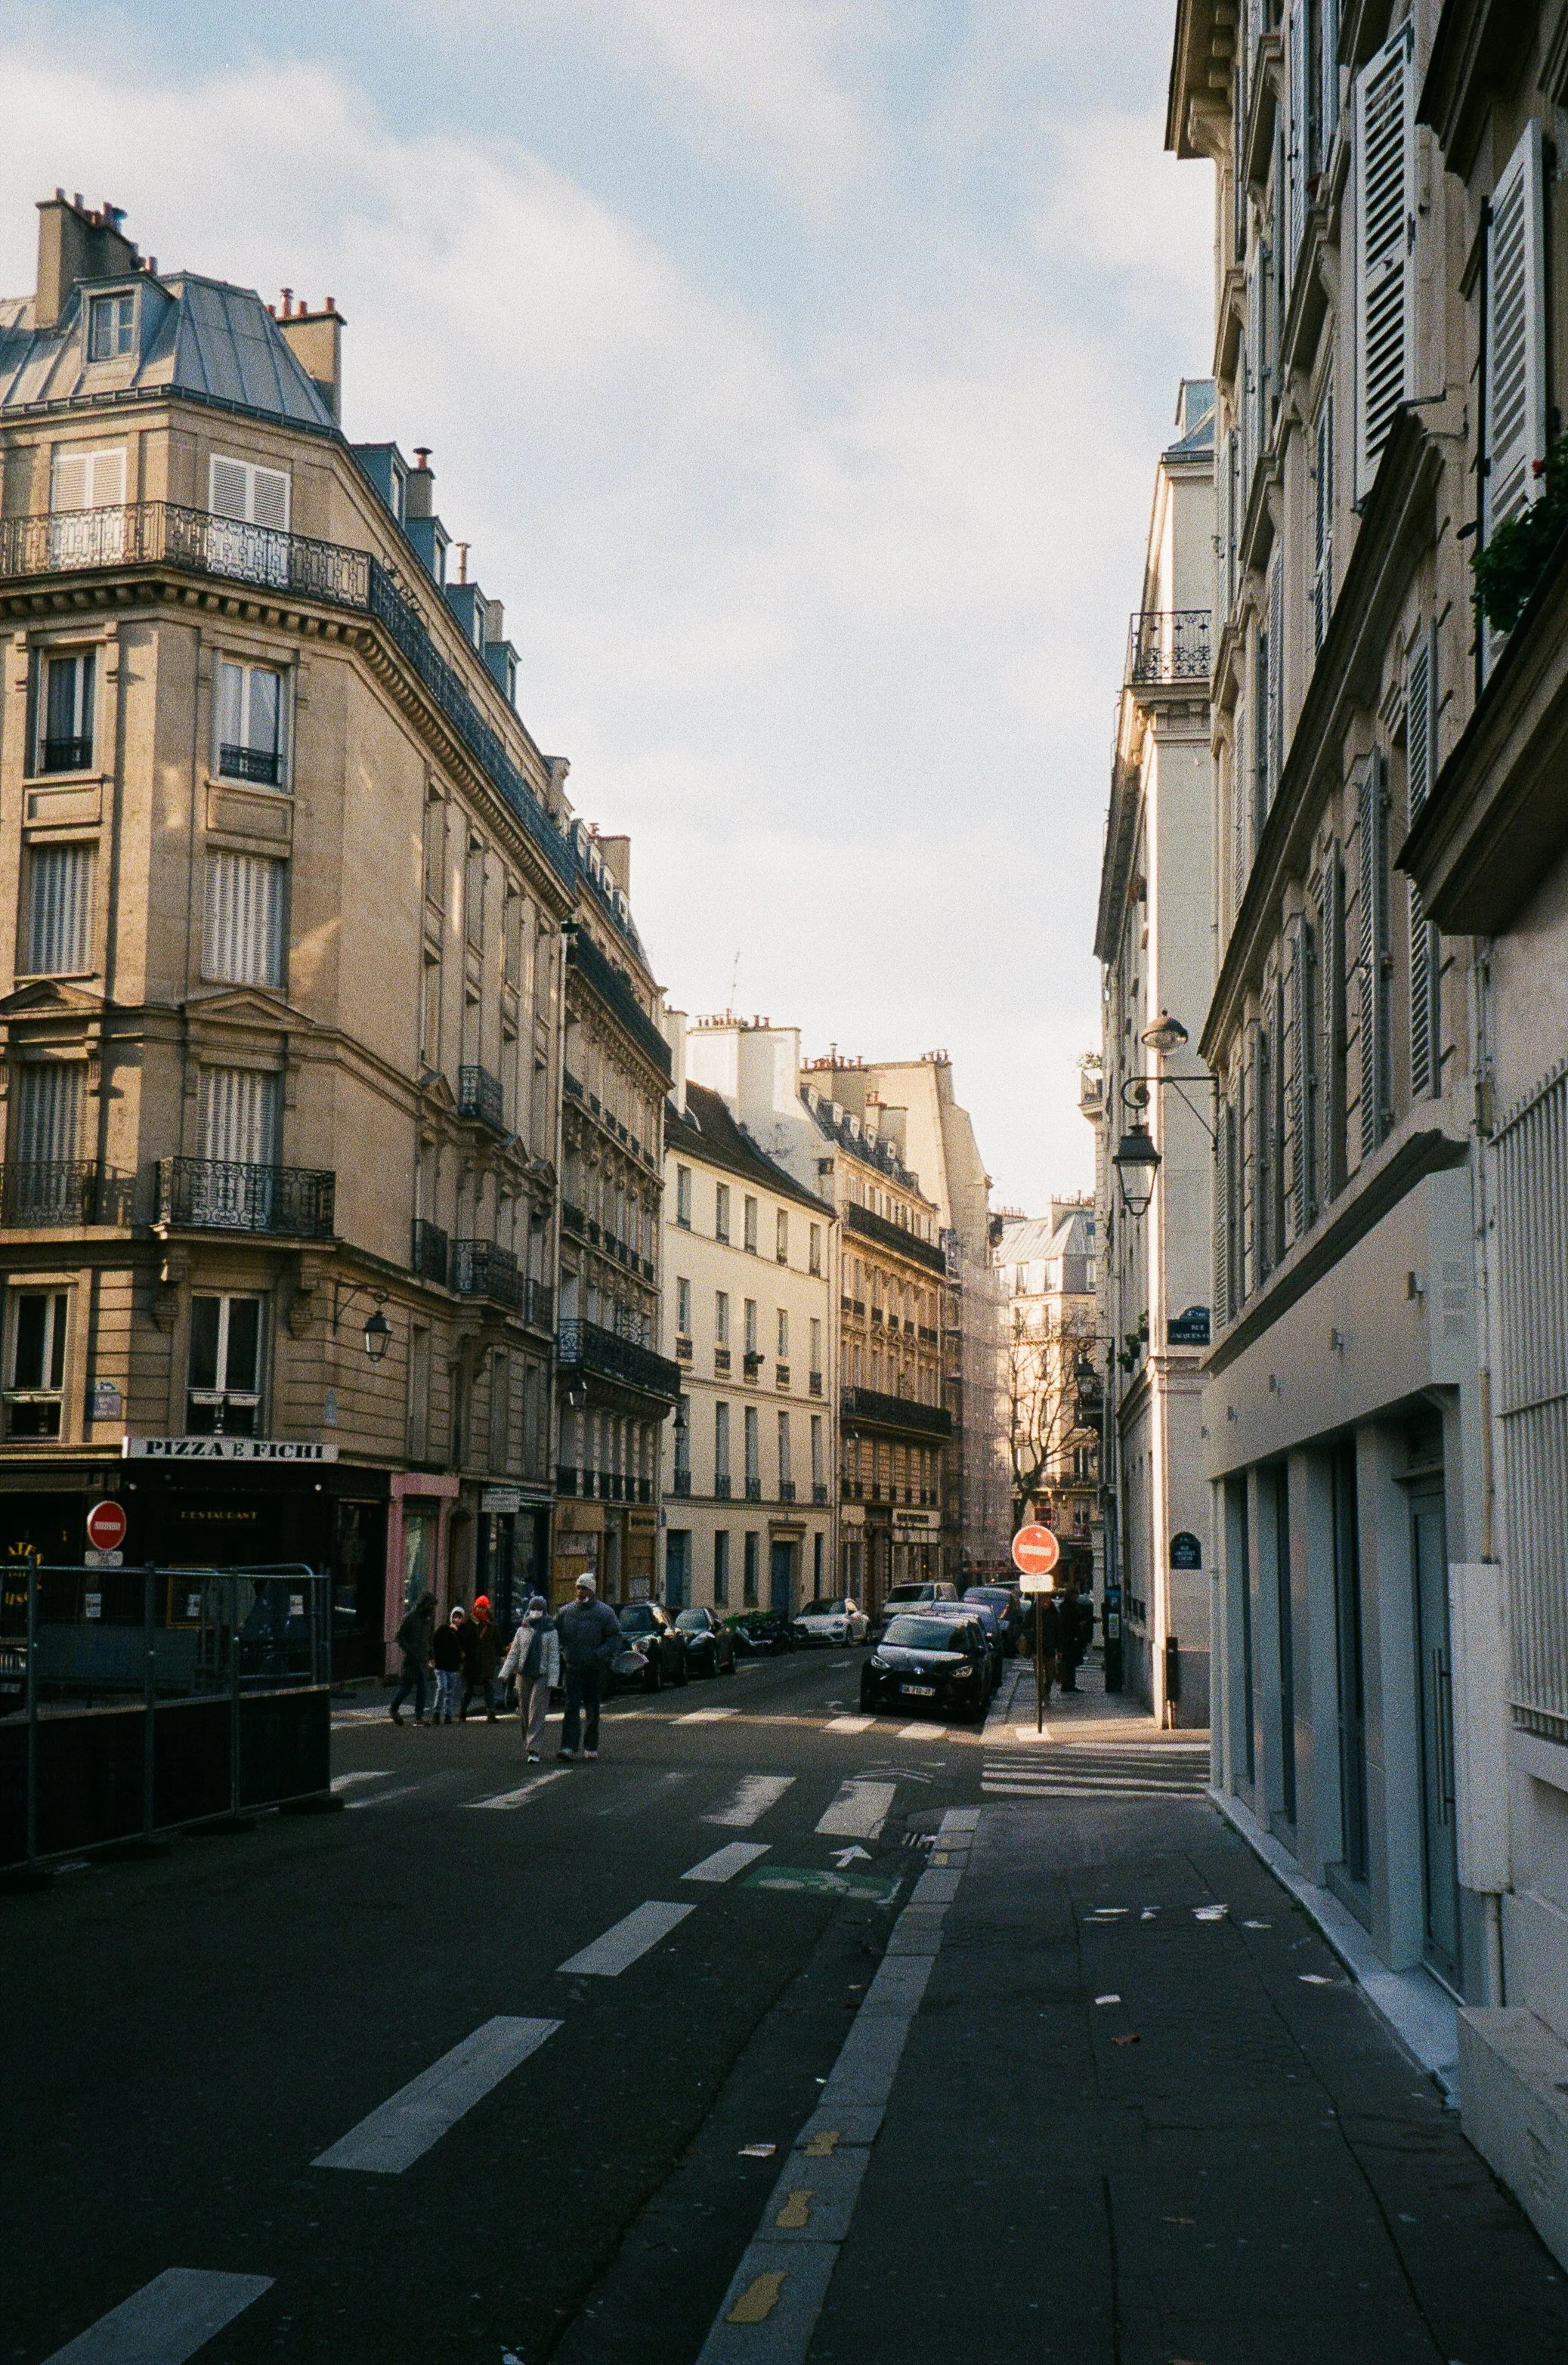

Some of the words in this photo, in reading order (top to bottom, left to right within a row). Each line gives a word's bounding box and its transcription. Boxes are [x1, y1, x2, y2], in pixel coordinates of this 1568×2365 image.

[146, 1440, 224, 1457] PIZZA
[233, 1442, 244, 1457] E
[252, 1444, 323, 1459] FICHI
[181, 1510, 258, 1519] RESTAURANT
